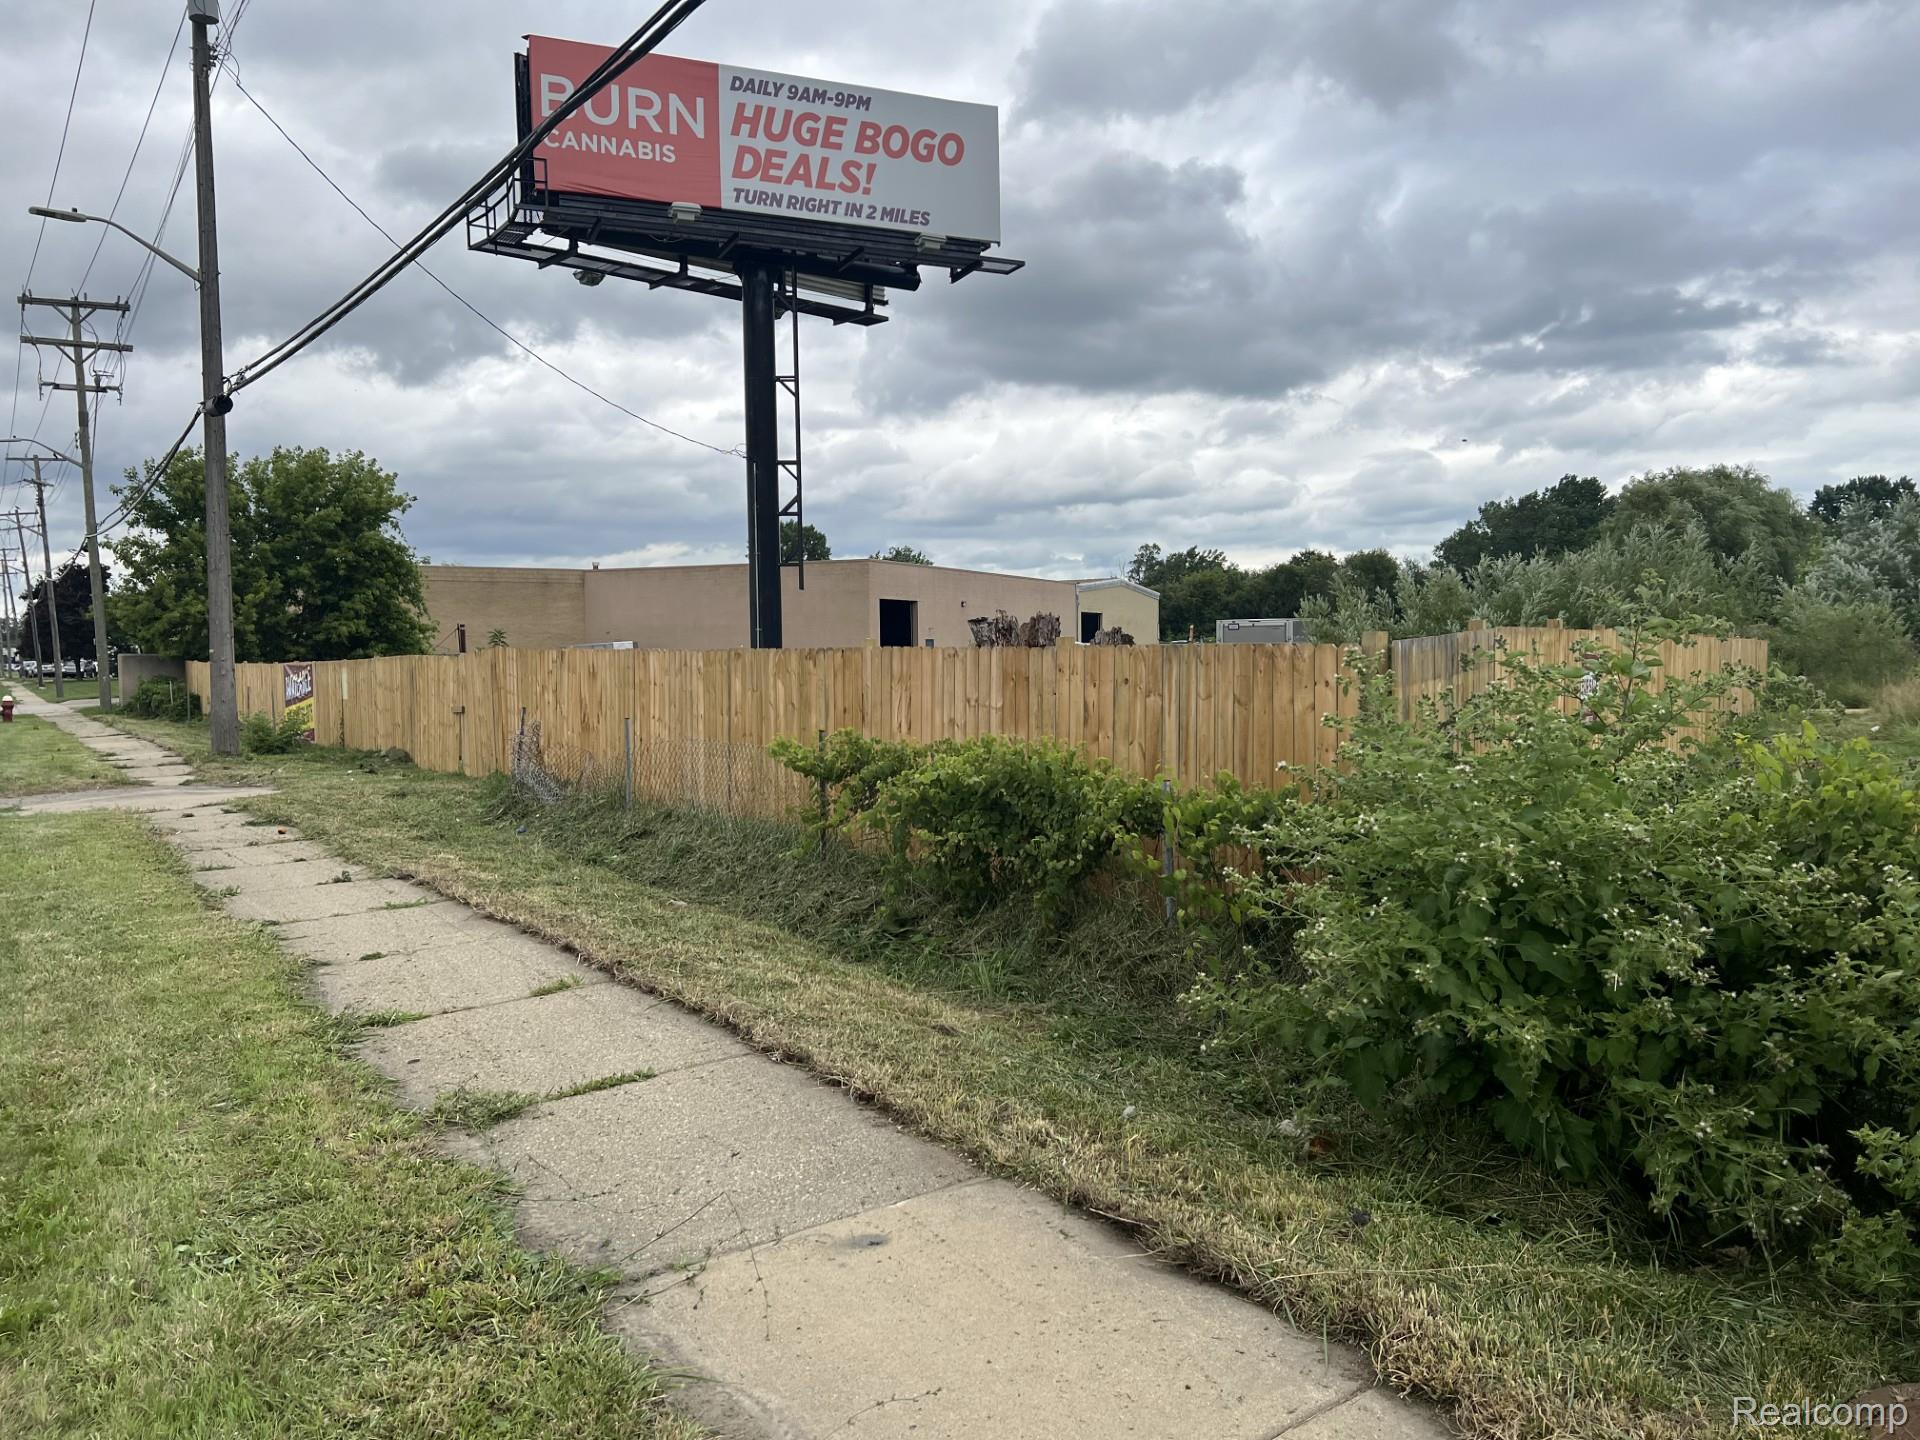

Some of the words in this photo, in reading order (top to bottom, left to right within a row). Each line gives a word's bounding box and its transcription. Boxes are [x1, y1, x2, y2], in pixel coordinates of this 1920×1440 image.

[730, 76, 785, 97] DAILY
[787, 83, 872, 111] 9AM-9PM
[543, 129, 676, 164] CANNABIS
[730, 102, 848, 150] HUGE
[854, 121, 965, 166] BOGO
[731, 145, 877, 195] DEALS!
[733, 188, 783, 209] TURN
[786, 195, 843, 216] RIGHT
[844, 203, 863, 218] IN
[866, 206, 878, 220] 2
[880, 208, 931, 226] MILES
